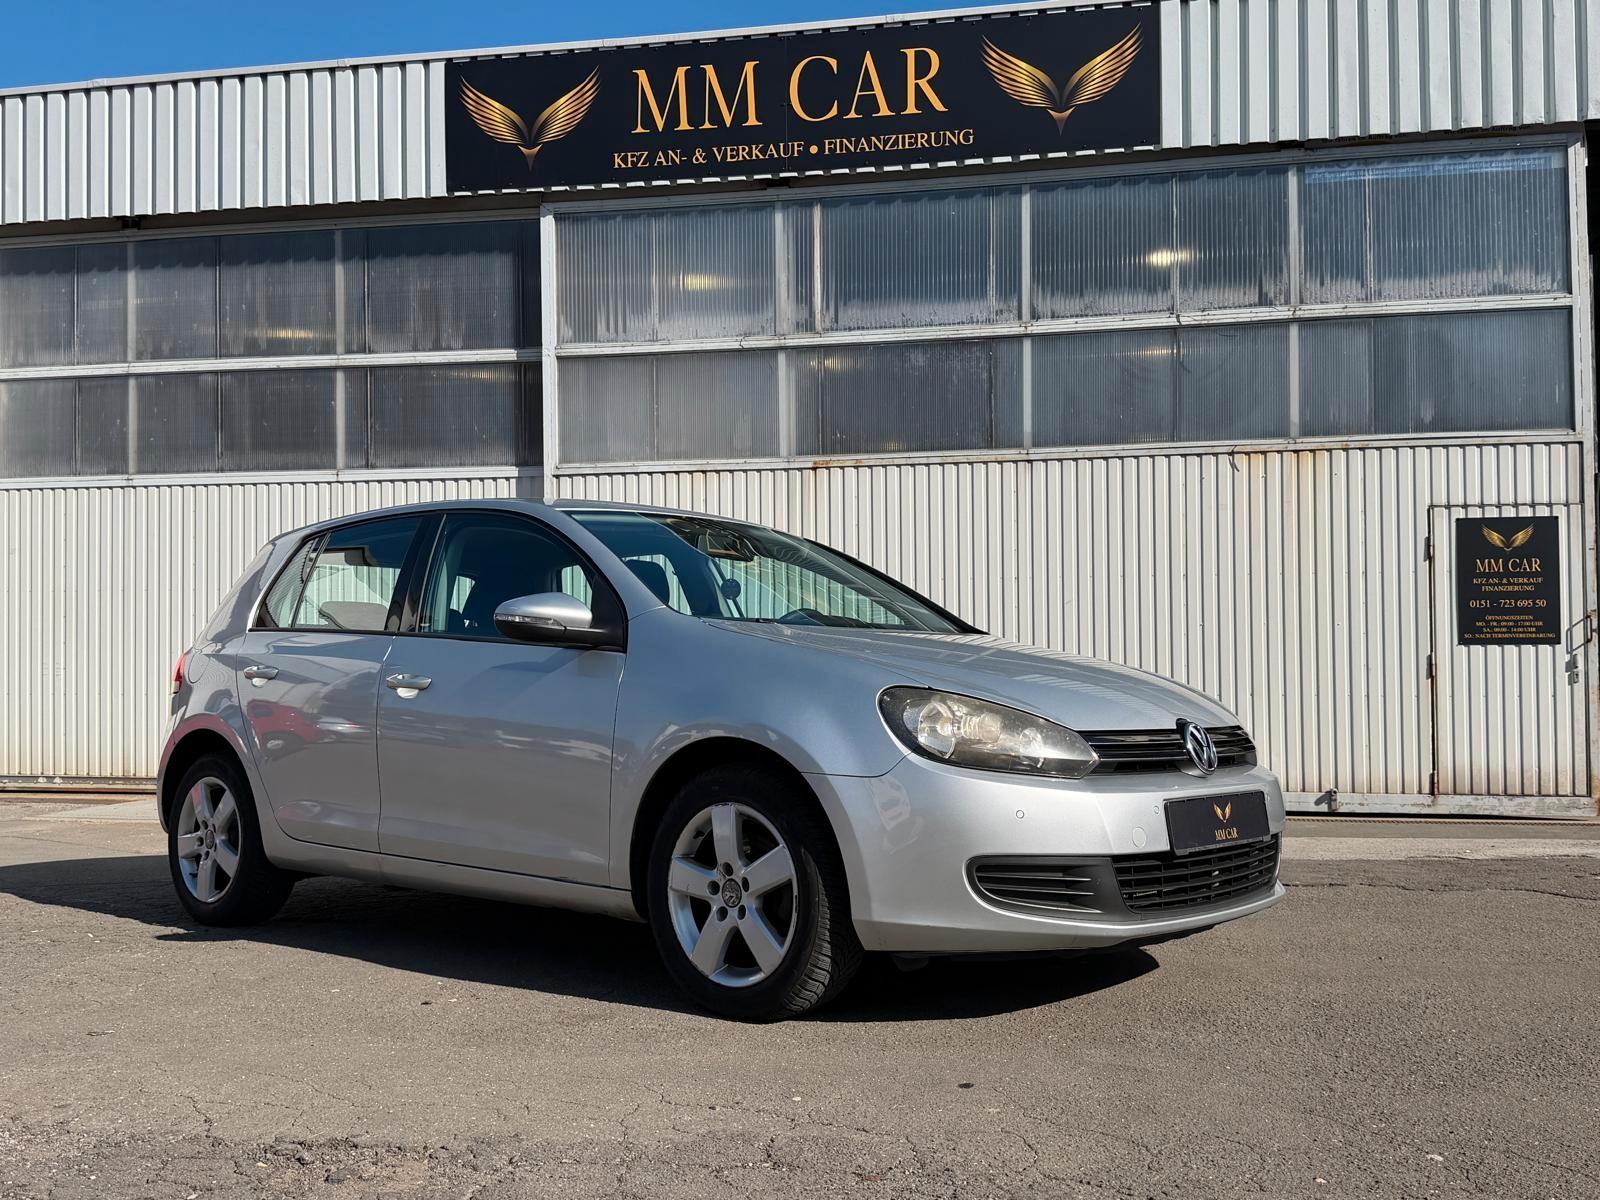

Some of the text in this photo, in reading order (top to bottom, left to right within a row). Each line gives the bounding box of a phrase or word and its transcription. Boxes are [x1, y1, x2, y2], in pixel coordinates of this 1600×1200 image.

[631, 47, 949, 134] MM CAR
[613, 129, 975, 169] KFZ AN- & VERKAUF FINANZIERUNG
[1476, 557, 1541, 573] MM CAR
[1469, 599, 1491, 608] 0151
[1499, 599, 1515, 608] 723
[1517, 599, 1533, 608] 695
[1535, 599, 1547, 608] 50
